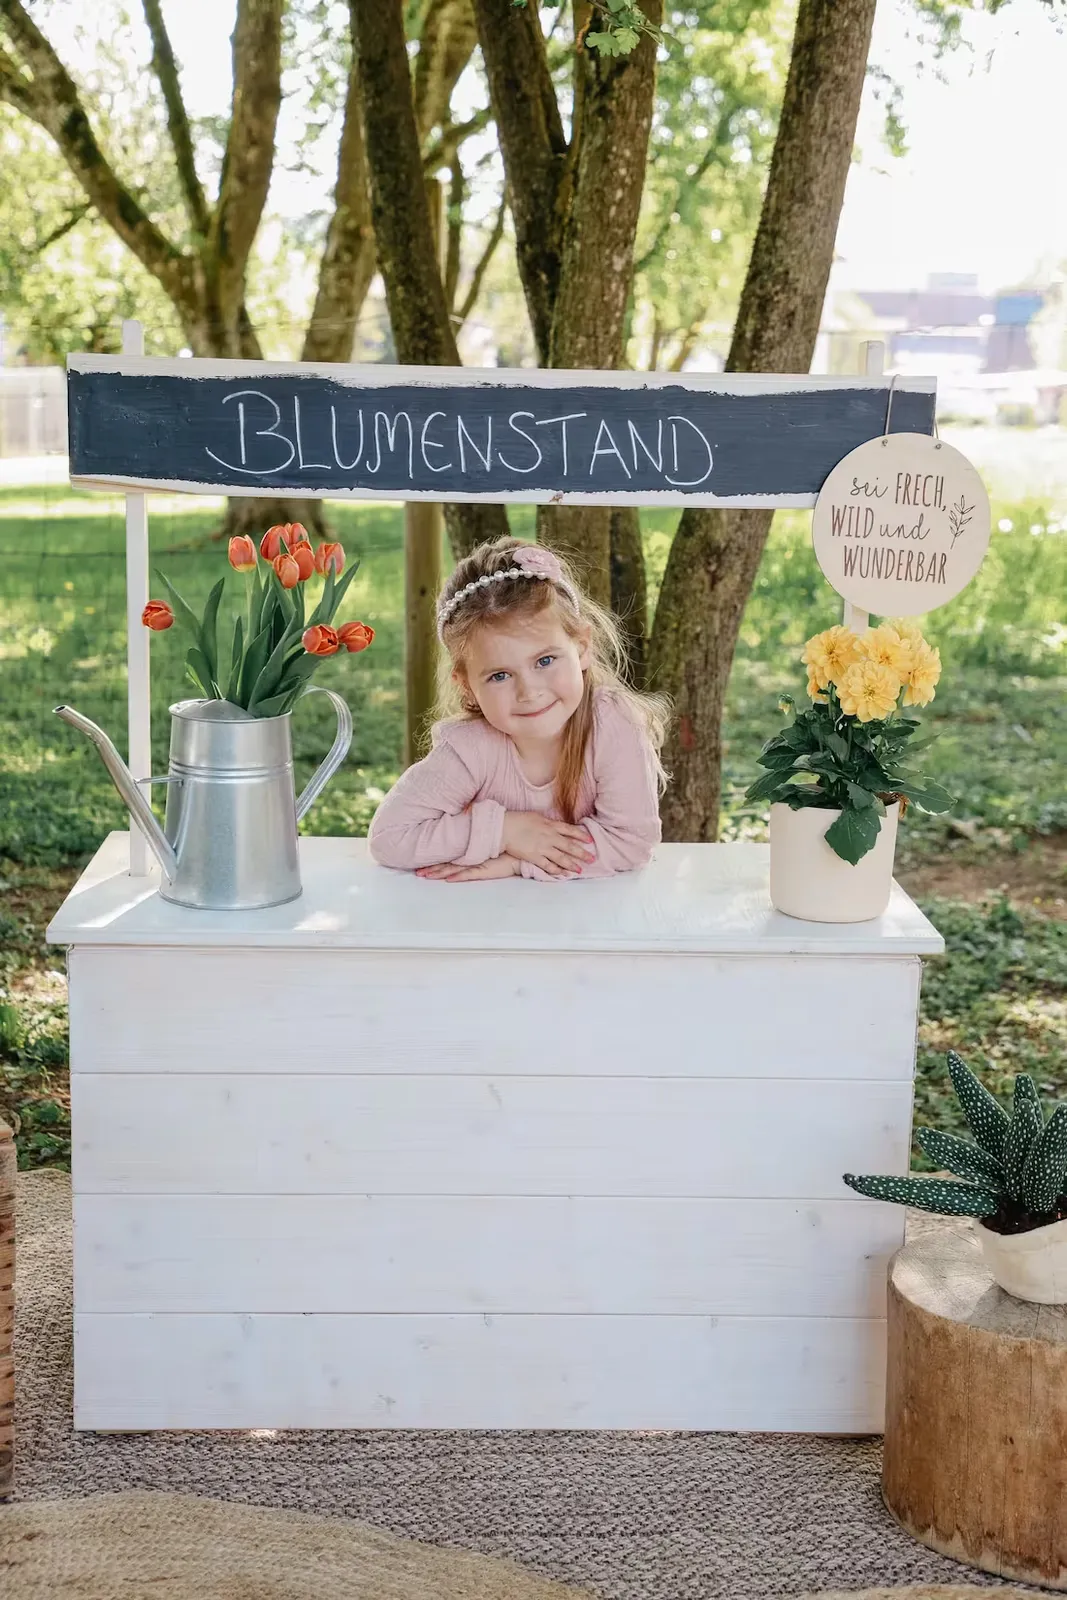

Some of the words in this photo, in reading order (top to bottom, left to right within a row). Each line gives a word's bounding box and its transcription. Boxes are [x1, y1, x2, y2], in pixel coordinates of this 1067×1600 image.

[204, 389, 713, 486] BLUMENSTAND
[849, 477, 889, 498] sei
[895, 472, 947, 512] FRECH,
[831, 504, 874, 539] WILD
[879, 513, 931, 540] und
[843, 545, 947, 585] WUNDERBAR
